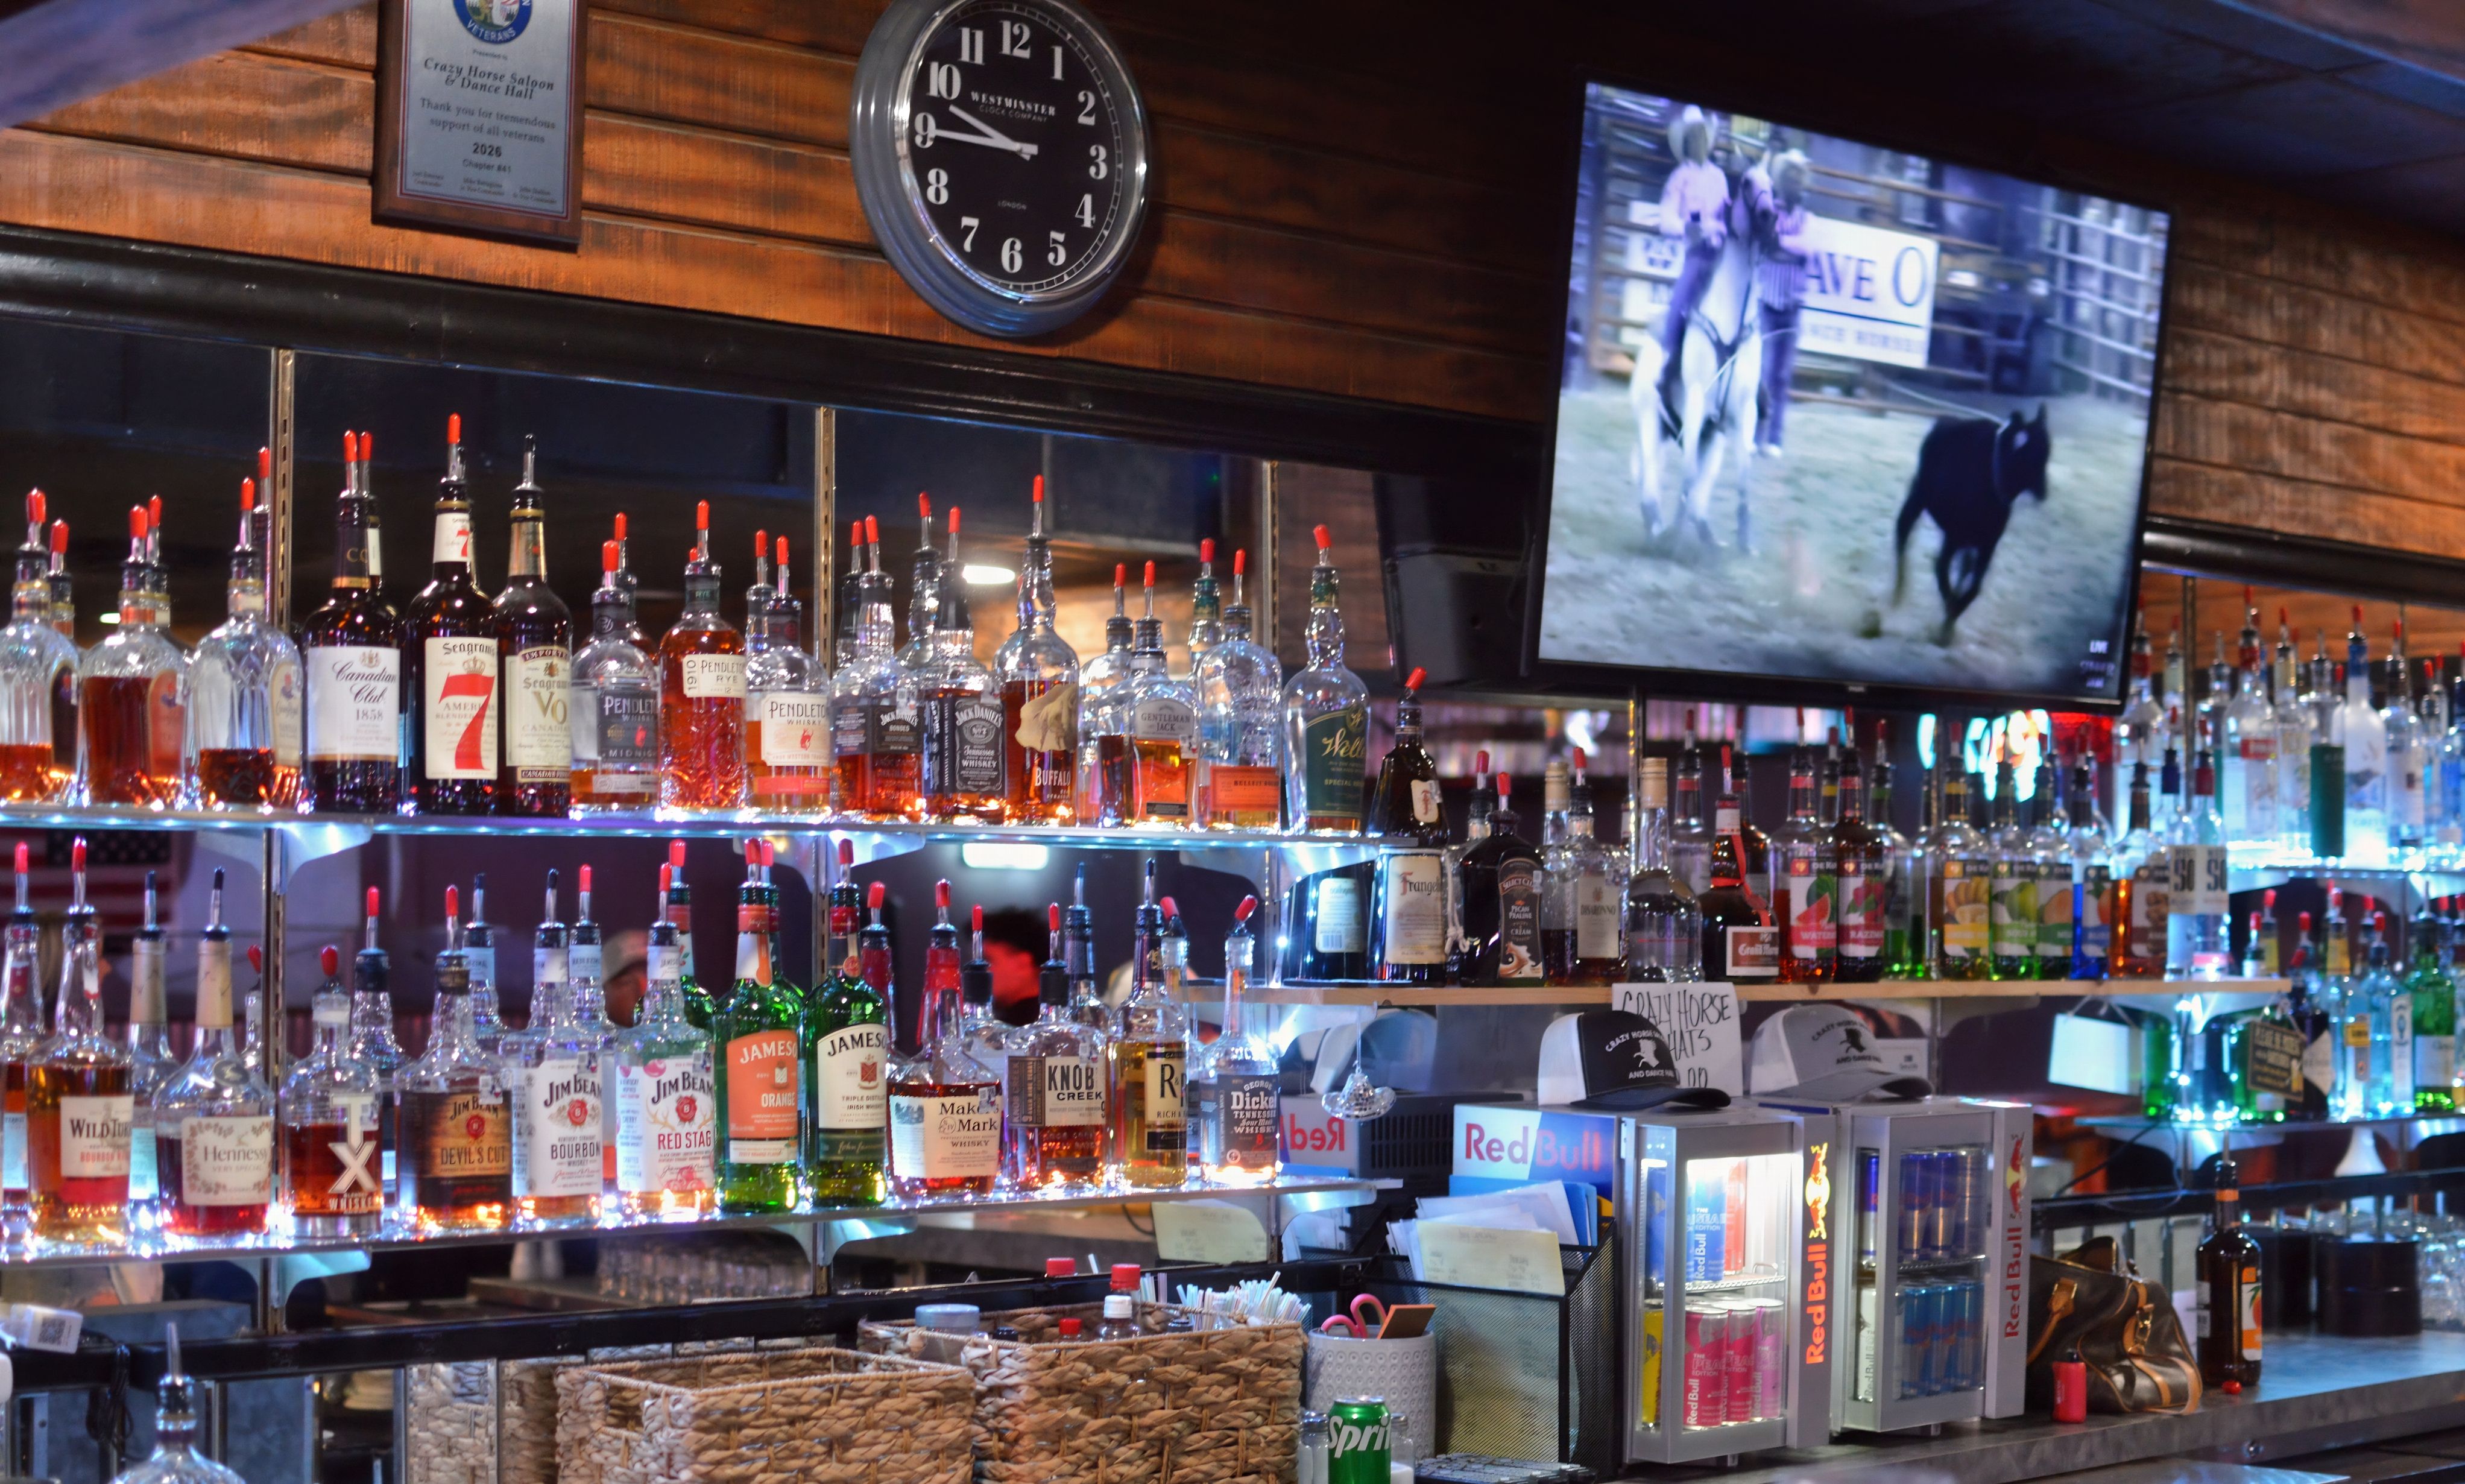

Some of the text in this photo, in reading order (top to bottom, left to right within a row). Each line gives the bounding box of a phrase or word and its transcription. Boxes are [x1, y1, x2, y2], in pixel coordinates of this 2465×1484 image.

[467, 19, 516, 42] VETERANS
[999, 20, 1031, 59] 12
[959, 27, 985, 65] 11
[424, 57, 555, 91] Crazy Horse Saloon
[1050, 45, 1064, 81] 1
[445, 75, 533, 99] & Dance Hall
[926, 62, 961, 100] 10
[420, 98, 556, 130] Thank you for tremendous
[971, 90, 1056, 117] WESTMINSTER
[979, 104, 1047, 122] CLOCK COMPANY
[1078, 90, 1096, 125] 2
[430, 118, 545, 144] support of all veterans
[914, 112, 936, 148] 9
[462, 159, 494, 172] Chapter
[1089, 145, 1108, 180] 3
[927, 168, 949, 205] 8
[997, 201, 1027, 211] LONDON
[1075, 194, 1096, 229] 4
[961, 216, 980, 253] 7
[1001, 237, 1023, 273] 6
[1047, 231, 1067, 266] 5
[442, 642, 496, 657] Seagram's
[332, 660, 397, 683] Canadian
[686, 660, 697, 692] 1910
[716, 675, 738, 683] RYE
[350, 683, 388, 704] Club
[356, 709, 383, 721] 1858
[532, 690, 568, 725] VO
[955, 704, 1004, 728] JACK DANIEL'S
[1140, 712, 1190, 724] GENTLEMAN
[438, 672, 496, 771] 7
[1157, 722, 1176, 732] JACK
[964, 745, 995, 757] Tennessee
[962, 759, 998, 768] WHISKEY
[1035, 767, 1072, 786] BUFFALO
[1503, 877, 1523, 891] SELECT
[1510, 905, 1530, 914] PECAN
[1678, 990, 1732, 1029] HORSE
[1605, 1029, 1654, 1052] CRAZY HORSE
[1811, 1024, 1835, 1041] CRAZY
[1668, 1029, 1712, 1061] HATS
[1047, 1064, 1094, 1091] KNOB
[1243, 1080, 1273, 1091] GEORGE
[1629, 1070, 1644, 1079] AND
[544, 1080, 571, 1108] JIM
[651, 1071, 714, 1105] JIM BEAM
[1056, 1091, 1103, 1101] CREEK
[449, 1100, 470, 1121] JIM
[761, 1092, 795, 1108] ORANGE
[1230, 1090, 1277, 1110] Dickel
[957, 1117, 998, 1132] Mark
[1157, 1110, 1176, 1119] RICH
[1240, 1118, 1258, 1127] Sour
[70, 1118, 109, 1139] WILD
[1233, 1126, 1276, 1134] WHISKY
[551, 1141, 601, 1160] BOURBON
[657, 1130, 712, 1151] RED STAG
[1465, 1123, 1600, 1172] Red Bull
[204, 1146, 268, 1164] Hennessy
[440, 1146, 505, 1165] DEVIL'S CUT
[567, 1159, 589, 1167] WHISKEY
[1694, 1233, 1706, 1280] Red Bull
[2004, 1225, 2023, 1340] Red Bull
[1805, 1243, 1828, 1365] Red Bull
[1687, 1378, 1700, 1425] Red Bull
